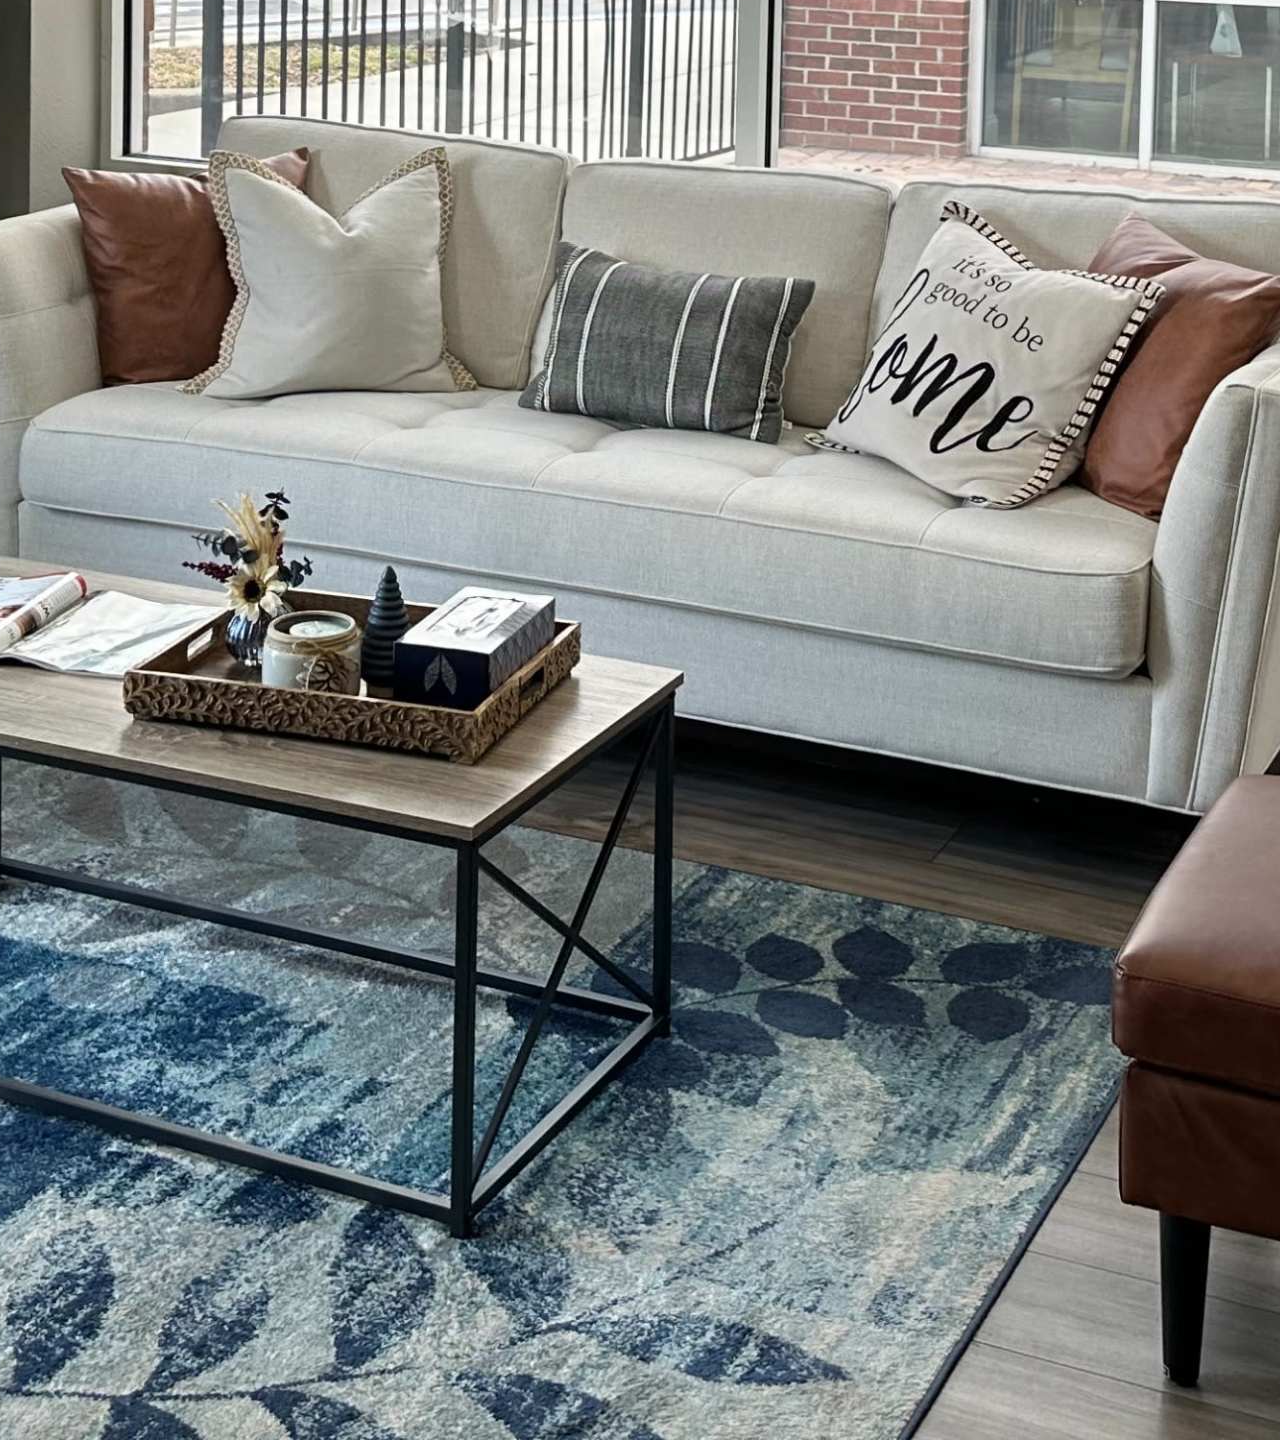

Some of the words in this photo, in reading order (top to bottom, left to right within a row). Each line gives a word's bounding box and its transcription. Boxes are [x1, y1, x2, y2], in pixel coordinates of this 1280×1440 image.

[952, 256, 986, 279] it's
[984, 274, 1012, 293] so
[924, 282, 987, 314] good
[982, 304, 1009, 329] to
[1011, 316, 1044, 352] be
